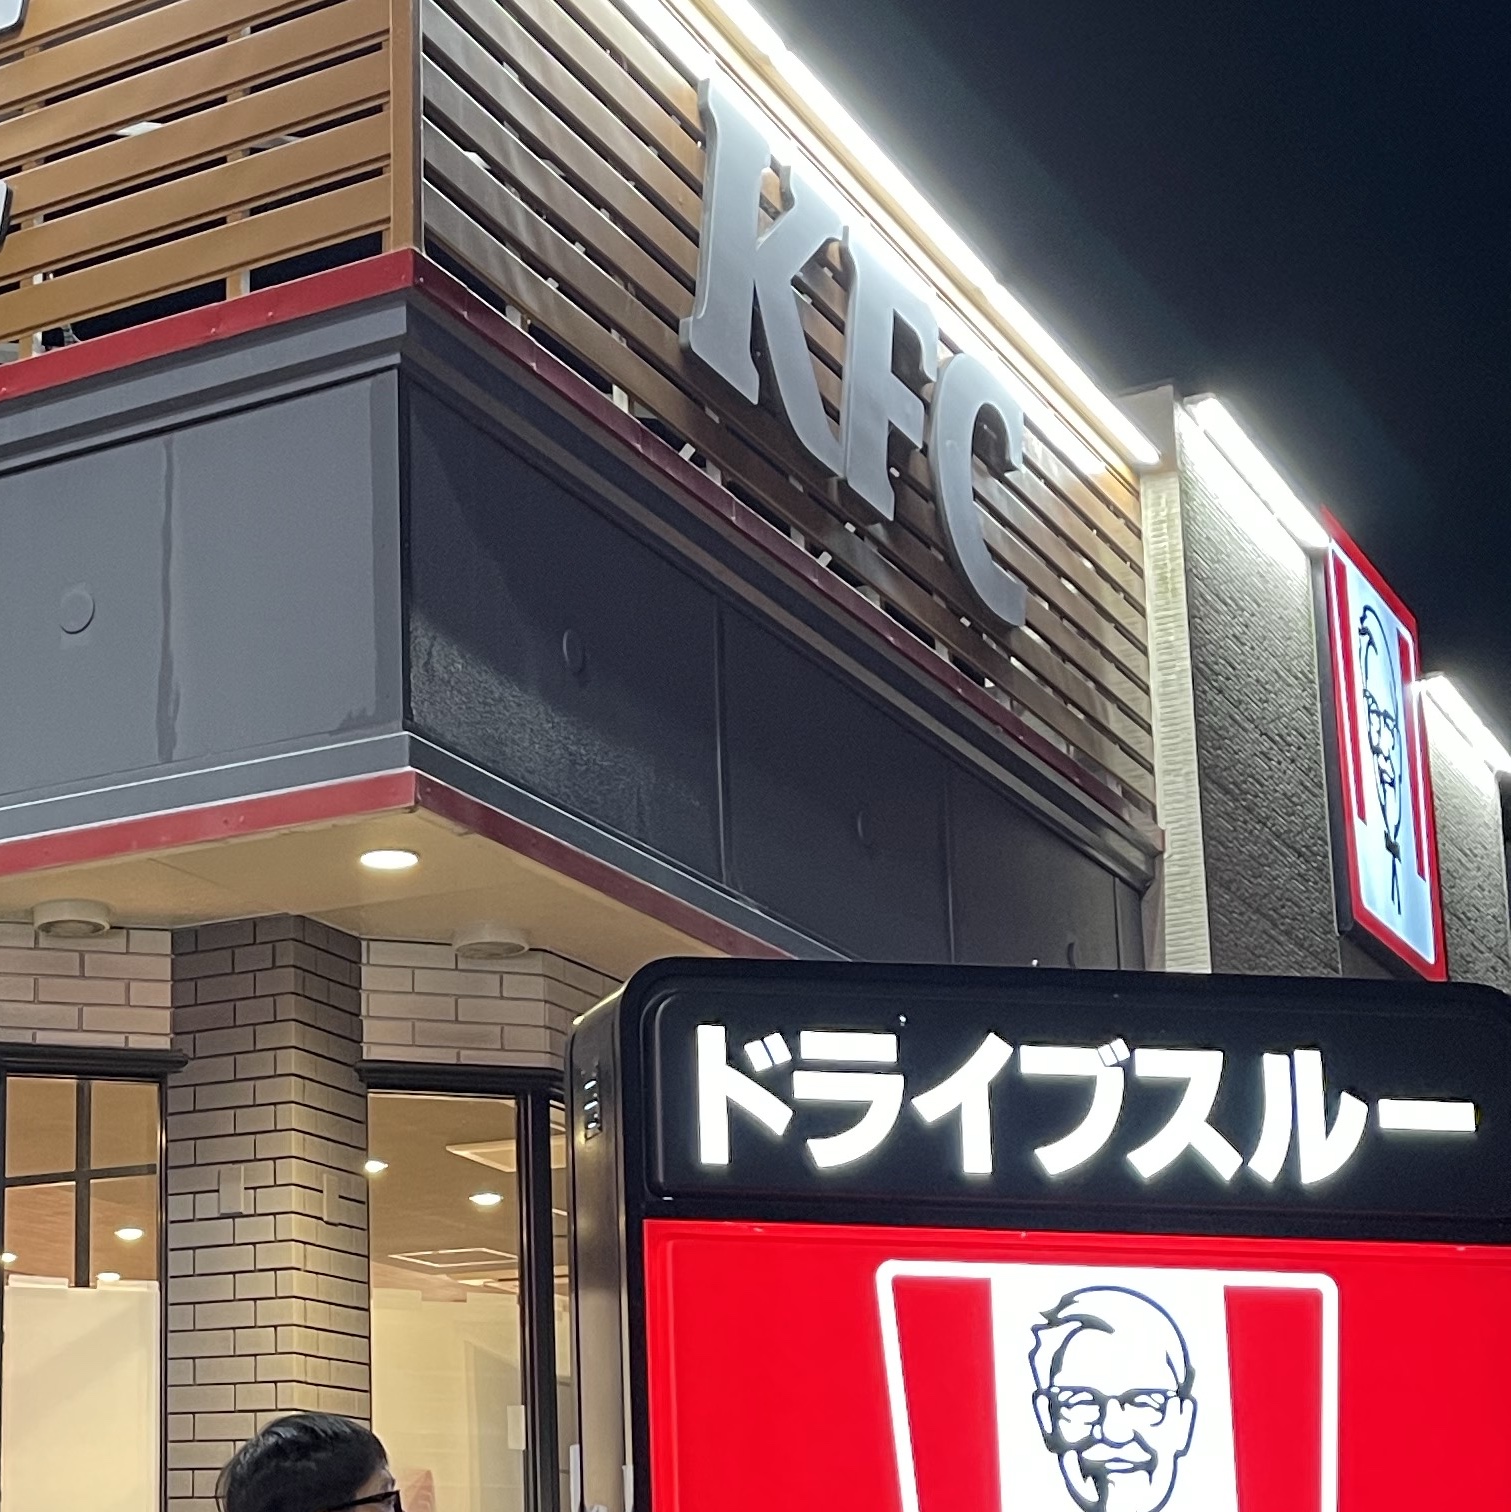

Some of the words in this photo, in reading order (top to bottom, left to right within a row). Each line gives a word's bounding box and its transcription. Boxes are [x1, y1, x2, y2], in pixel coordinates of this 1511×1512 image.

[679, 77, 1028, 629] KFC
[696, 1023, 1477, 1184] ドライブスルー
